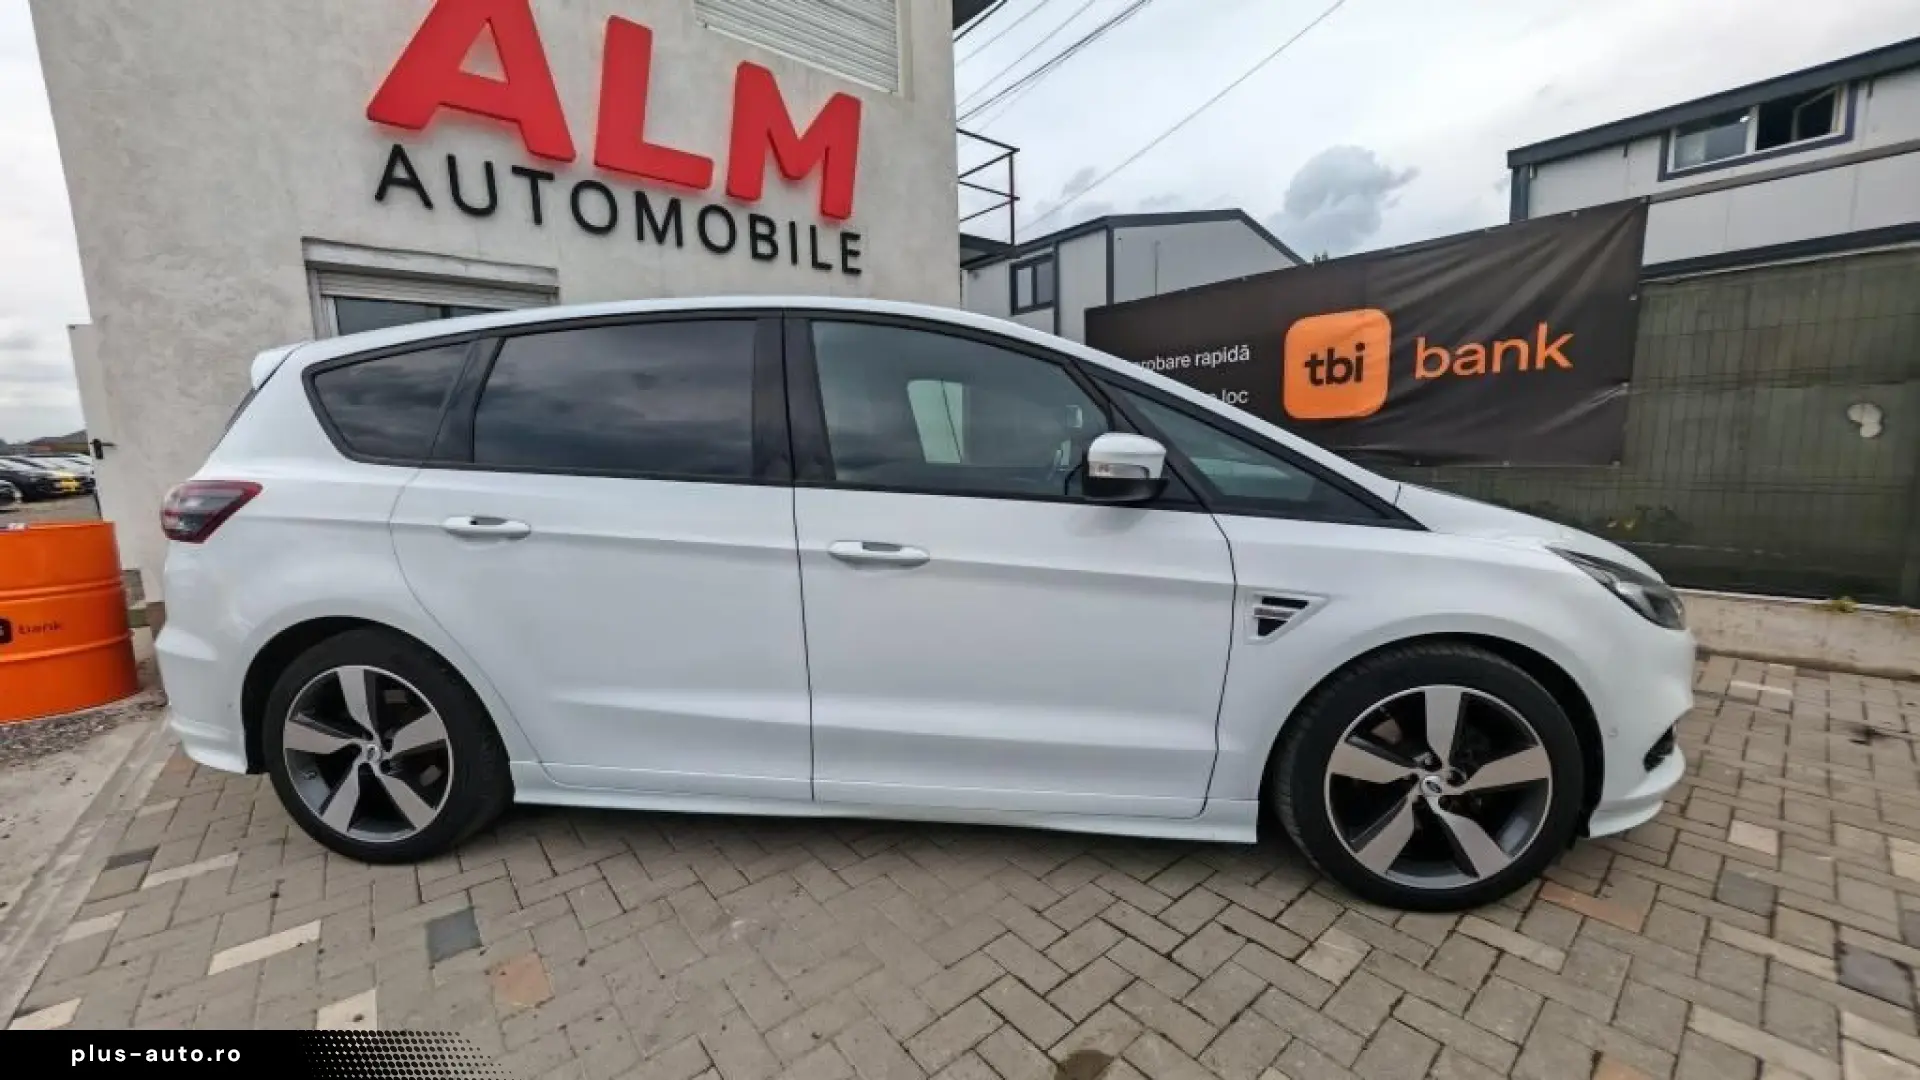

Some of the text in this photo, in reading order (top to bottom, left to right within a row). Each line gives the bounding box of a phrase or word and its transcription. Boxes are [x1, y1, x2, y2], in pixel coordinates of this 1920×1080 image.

[367, 0, 861, 220] ALM
[375, 144, 862, 275] AUTOMOBILE
[1221, 387, 1248, 404] loc
[1304, 322, 1575, 387] tbi bank
